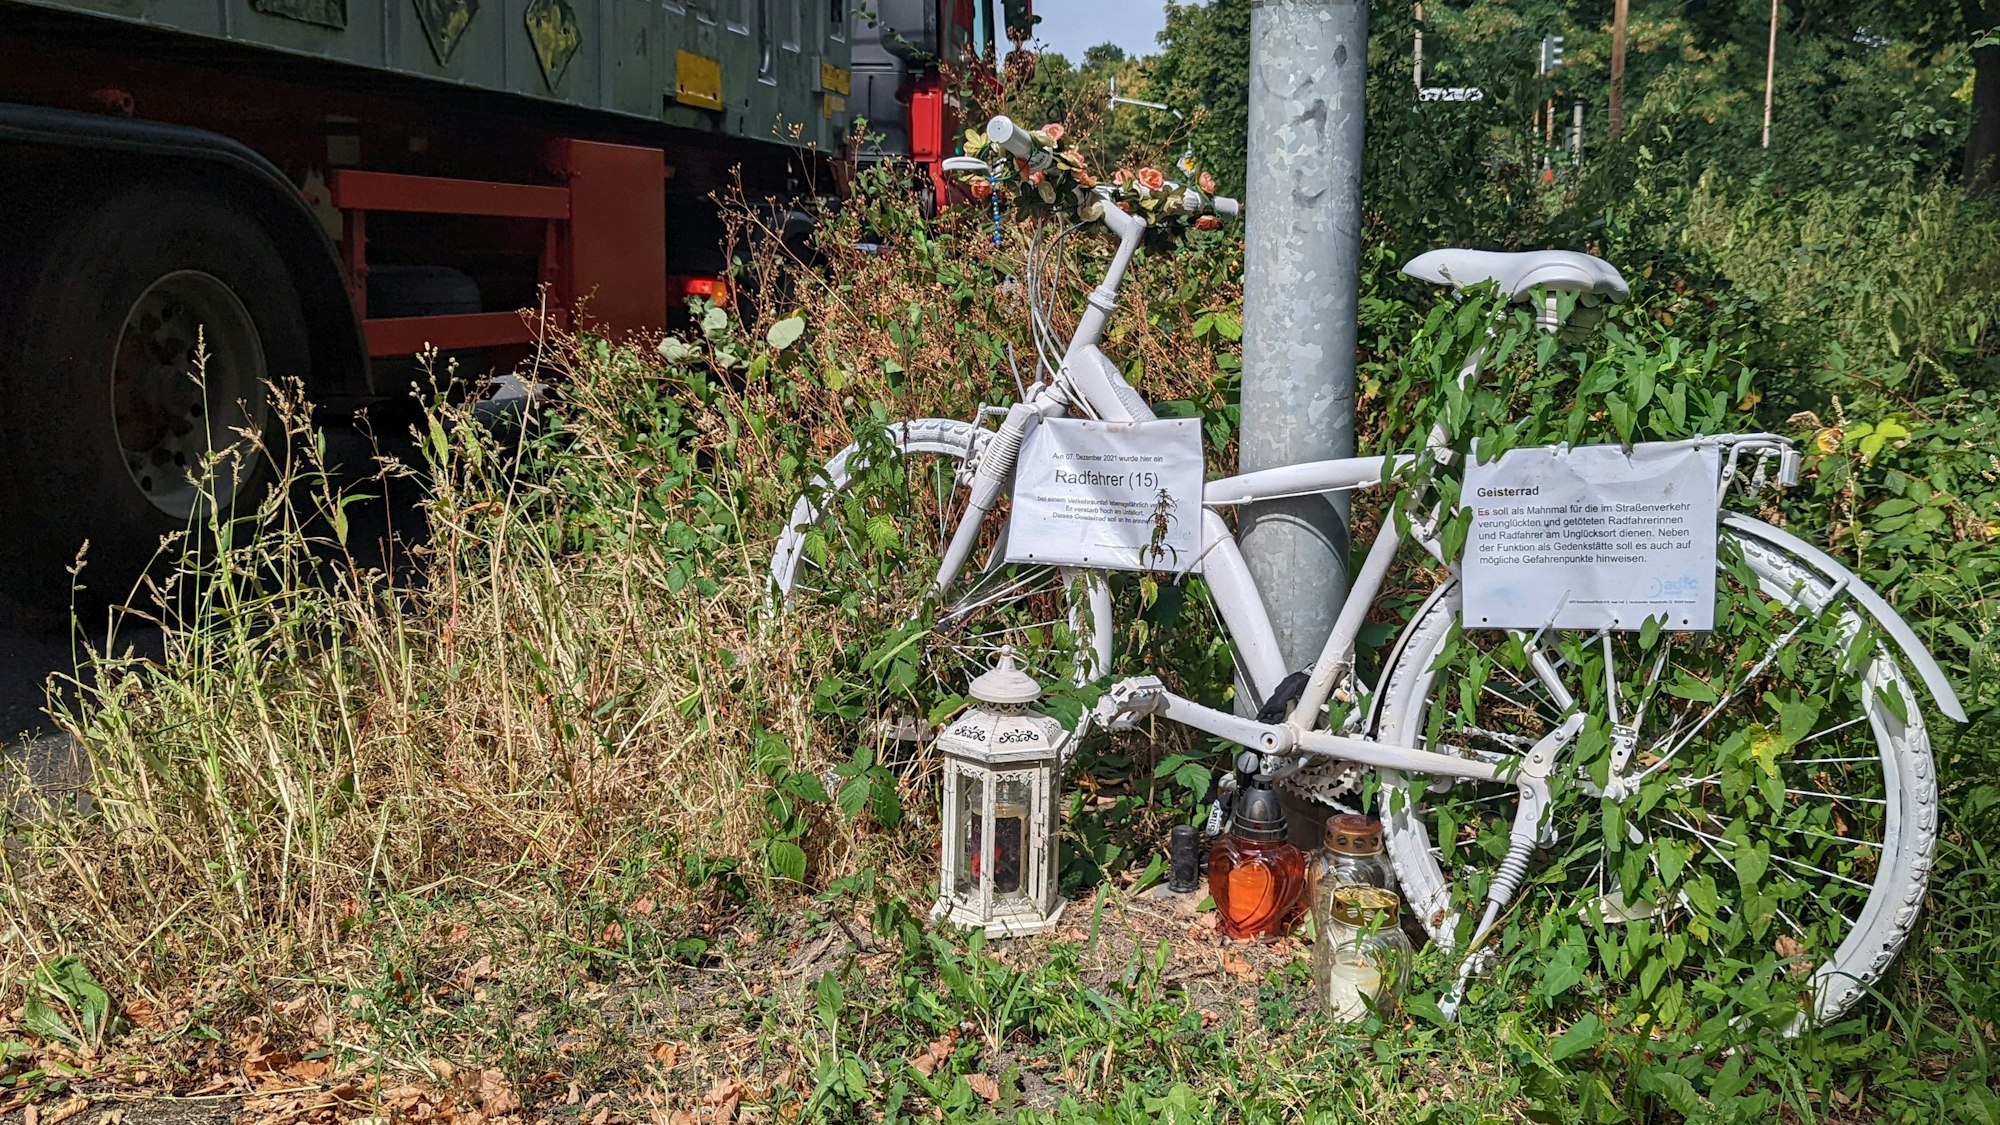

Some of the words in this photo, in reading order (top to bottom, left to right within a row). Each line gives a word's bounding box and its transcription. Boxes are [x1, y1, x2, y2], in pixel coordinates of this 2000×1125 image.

[1076, 453, 1102, 462] Dezember
[1103, 454, 1117, 462] 2021
[1055, 469, 1124, 487] Radfahrer
[1128, 471, 1159, 491] (15)
[1477, 486, 1540, 497] Geisterrad
[1477, 507, 1490, 516] Es
[1492, 506, 1509, 516] soll
[1511, 506, 1524, 515] als
[1526, 505, 1568, 515] Mahnmal
[1570, 504, 1582, 514] für
[1585, 503, 1598, 513] die
[1601, 503, 1613, 513] im
[1615, 502, 1691, 513] Straßenverkehr
[1478, 518, 1541, 529] verunglückten
[1543, 517, 1561, 528] und
[1563, 517, 1605, 528] getöteten
[1608, 515, 1683, 525] Radfahrerinnen
[1478, 531, 1496, 540] und
[1499, 530, 1543, 540] Radfahrer
[1546, 531, 1560, 539] am
[1562, 528, 1617, 540] Unglücksort
[1619, 528, 1655, 538] dienen.
[1658, 528, 1690, 537] Neben
[1479, 543, 1494, 552] der
[1497, 542, 1535, 552] Funktion
[1537, 542, 1551, 551] als
[1553, 541, 1613, 551] Gedenkstätte
[1616, 540, 1633, 550] soll
[1635, 542, 1647, 550] es
[1650, 540, 1674, 550] auch
[1676, 539, 1692, 550] auf
[1479, 555, 1520, 566] mögliche
[1522, 554, 1594, 565] Gefahrenpunkte
[1596, 553, 1647, 563] hinweisen.
